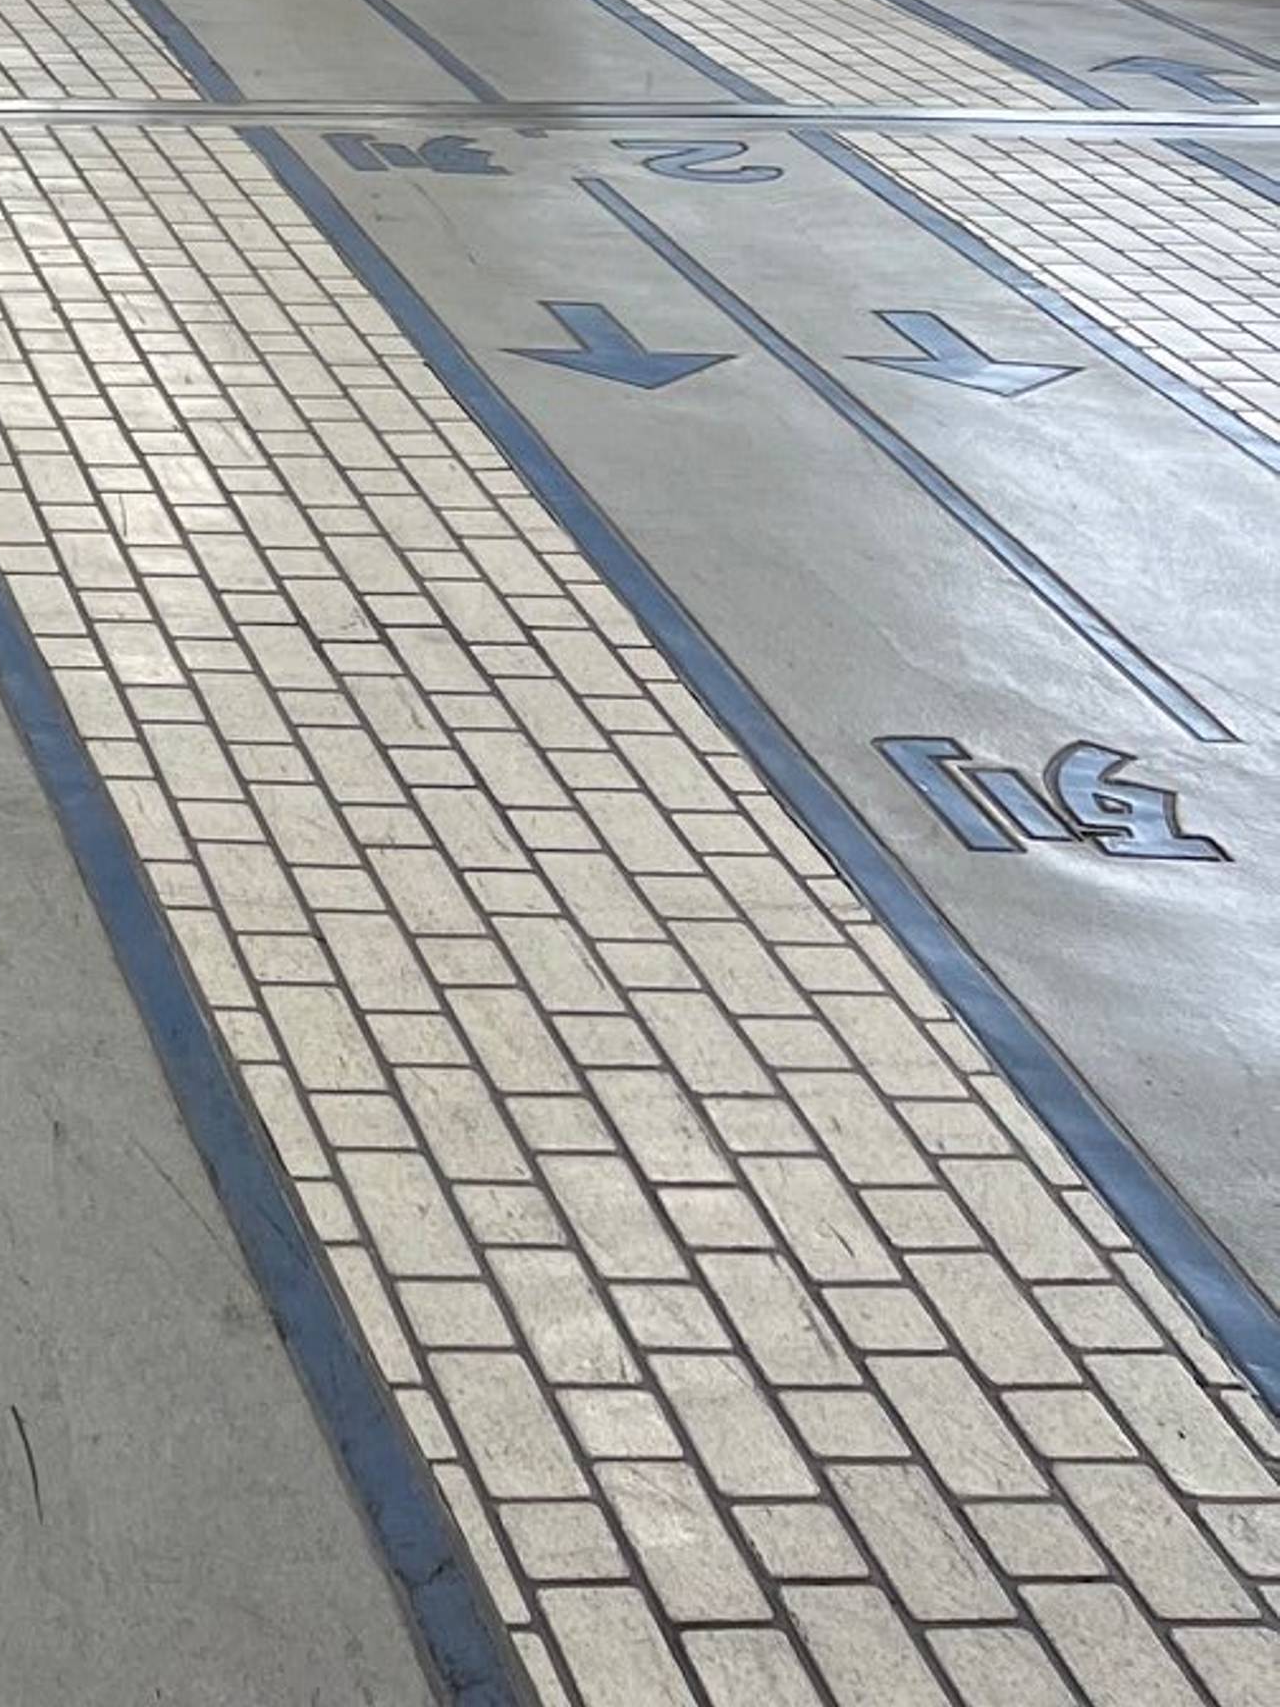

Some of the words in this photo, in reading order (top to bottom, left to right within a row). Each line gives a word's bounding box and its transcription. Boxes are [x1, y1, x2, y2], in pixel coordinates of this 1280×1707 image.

[320, 132, 513, 175] 列
[611, 139, 784, 184] 2
[871, 736, 1235, 863] 列
